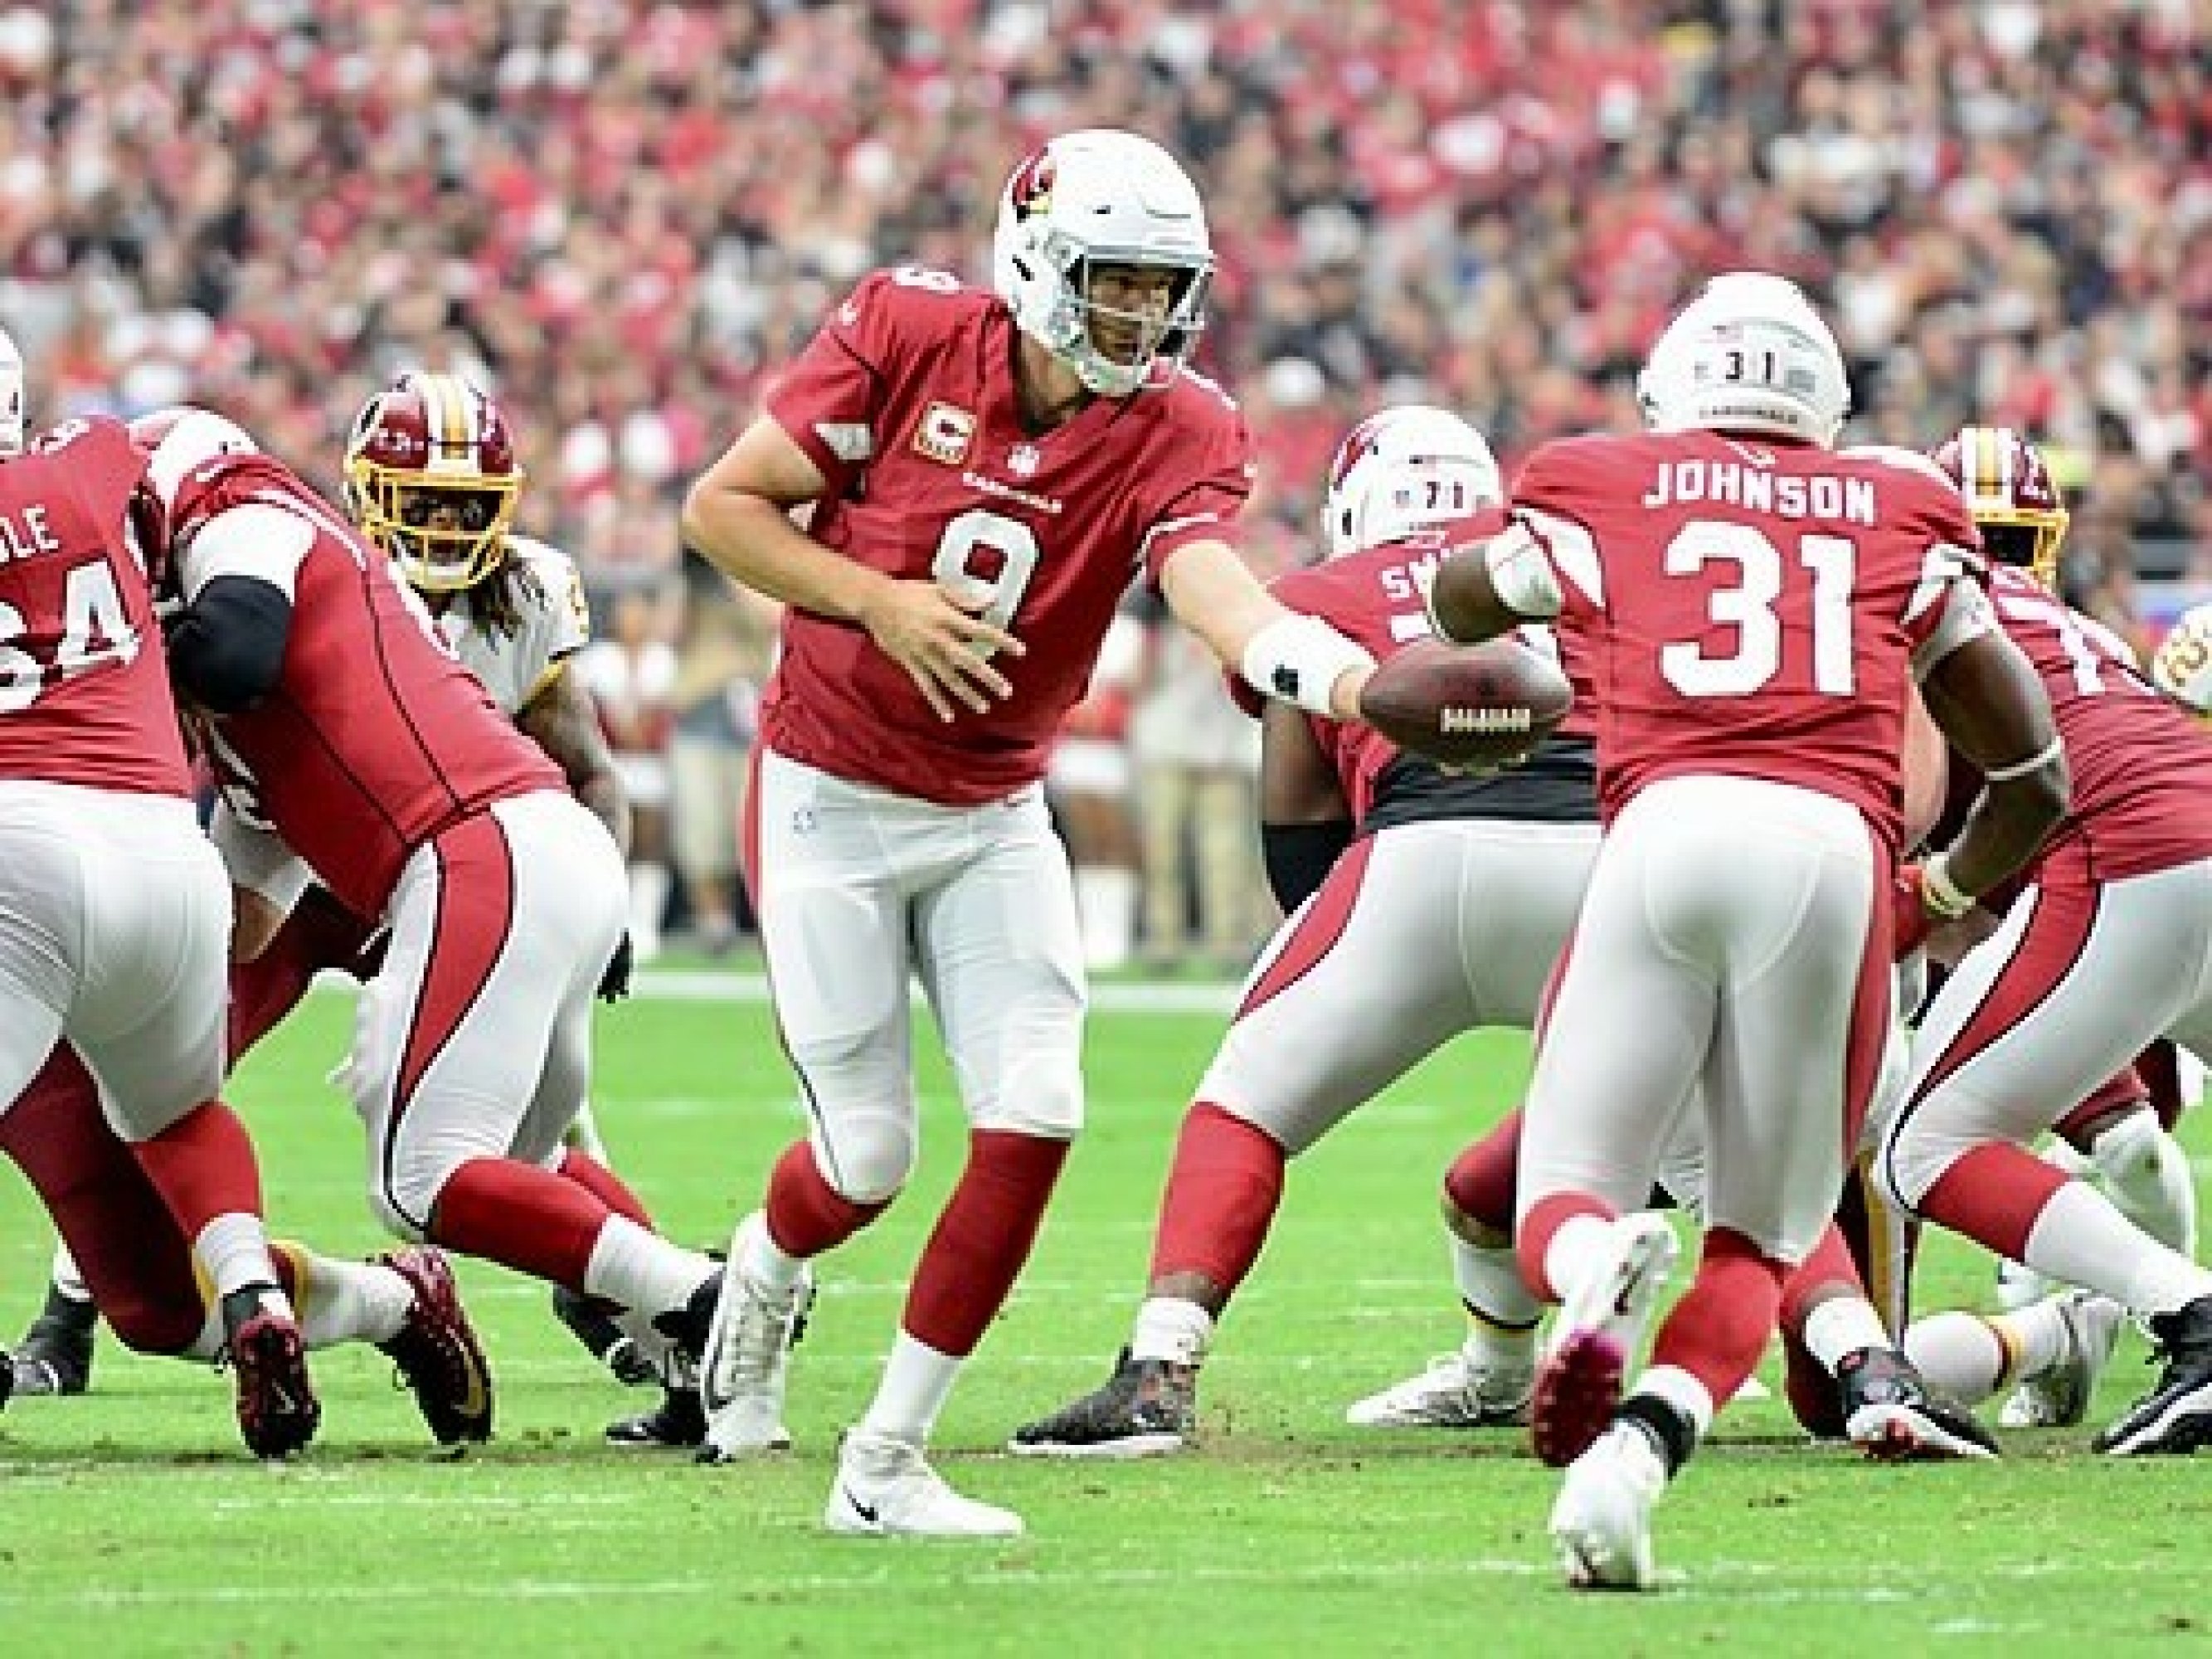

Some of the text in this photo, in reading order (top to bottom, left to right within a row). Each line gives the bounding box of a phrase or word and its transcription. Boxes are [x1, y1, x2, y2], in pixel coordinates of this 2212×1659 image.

[1724, 350, 1777, 382] 31
[1427, 480, 1466, 510] 71
[1641, 460, 1876, 527] JOHNSON
[1661, 518, 1856, 698] 31
